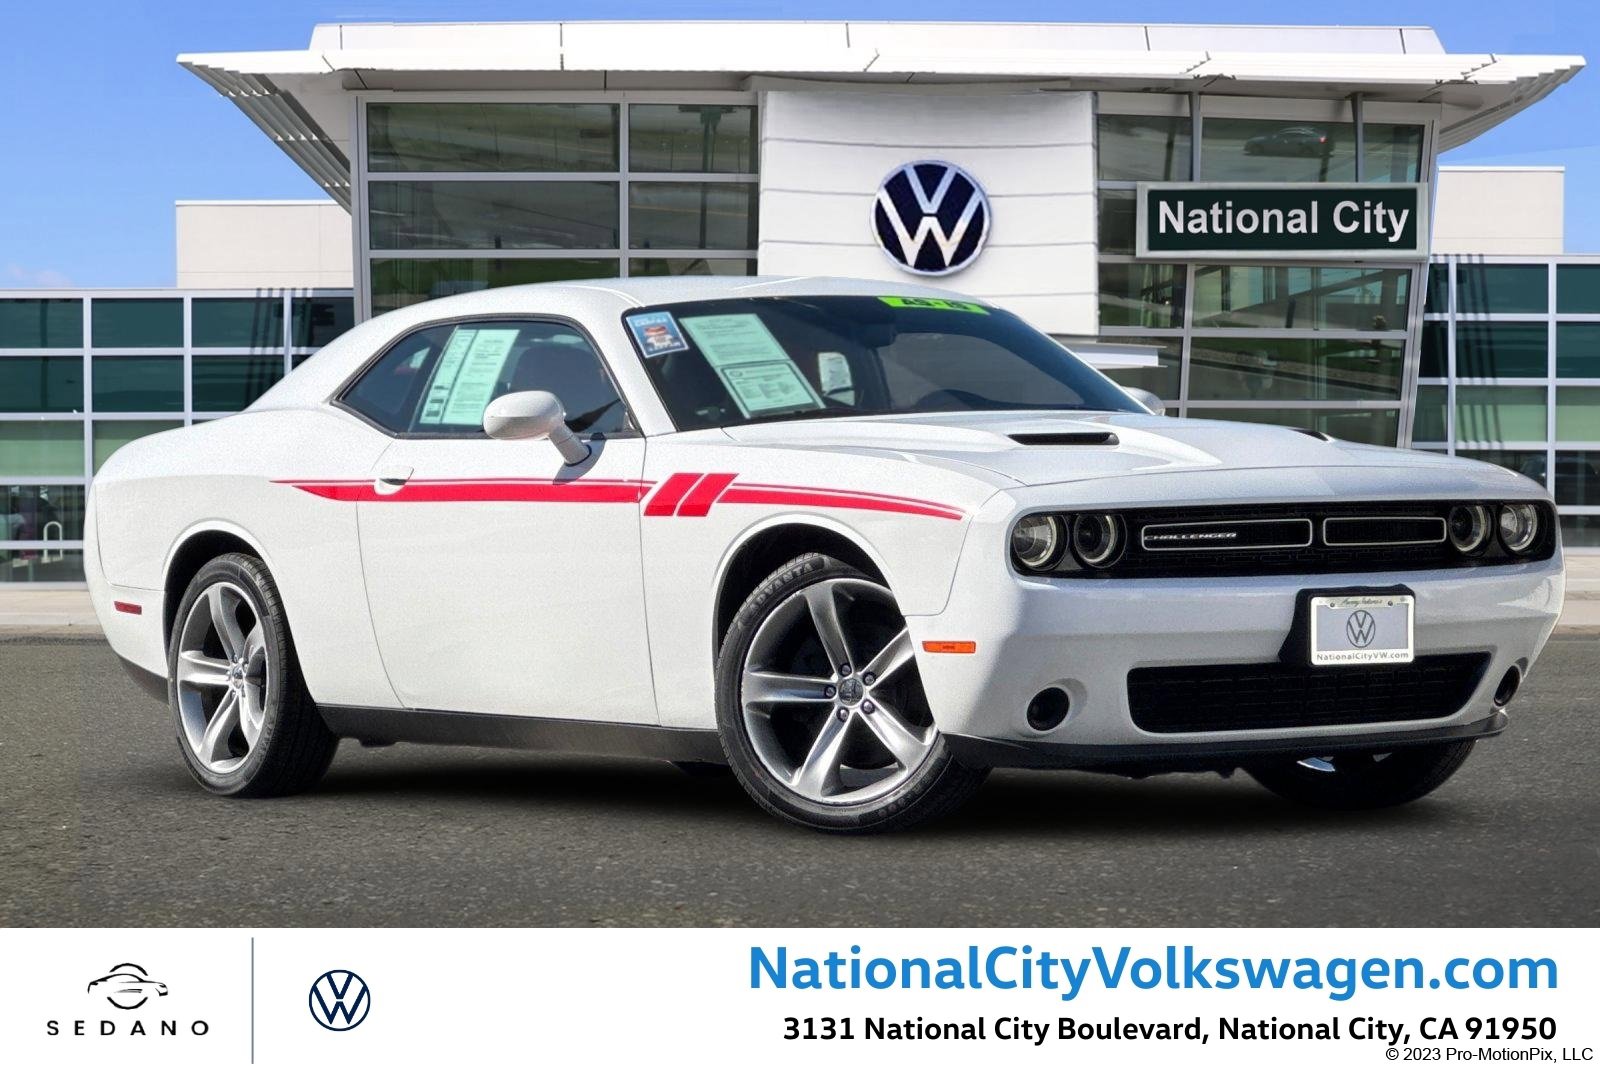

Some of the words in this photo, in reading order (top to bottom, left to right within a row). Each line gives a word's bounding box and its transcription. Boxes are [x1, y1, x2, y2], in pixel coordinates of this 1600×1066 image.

[872, 160, 990, 275] VW
[1158, 200, 1318, 234] National
[1333, 200, 1410, 243] City
[1144, 531, 1237, 541] CHALLENGER
[749, 562, 814, 610] ADVANTA
[1316, 651, 1409, 661] NationalCityVW.com
